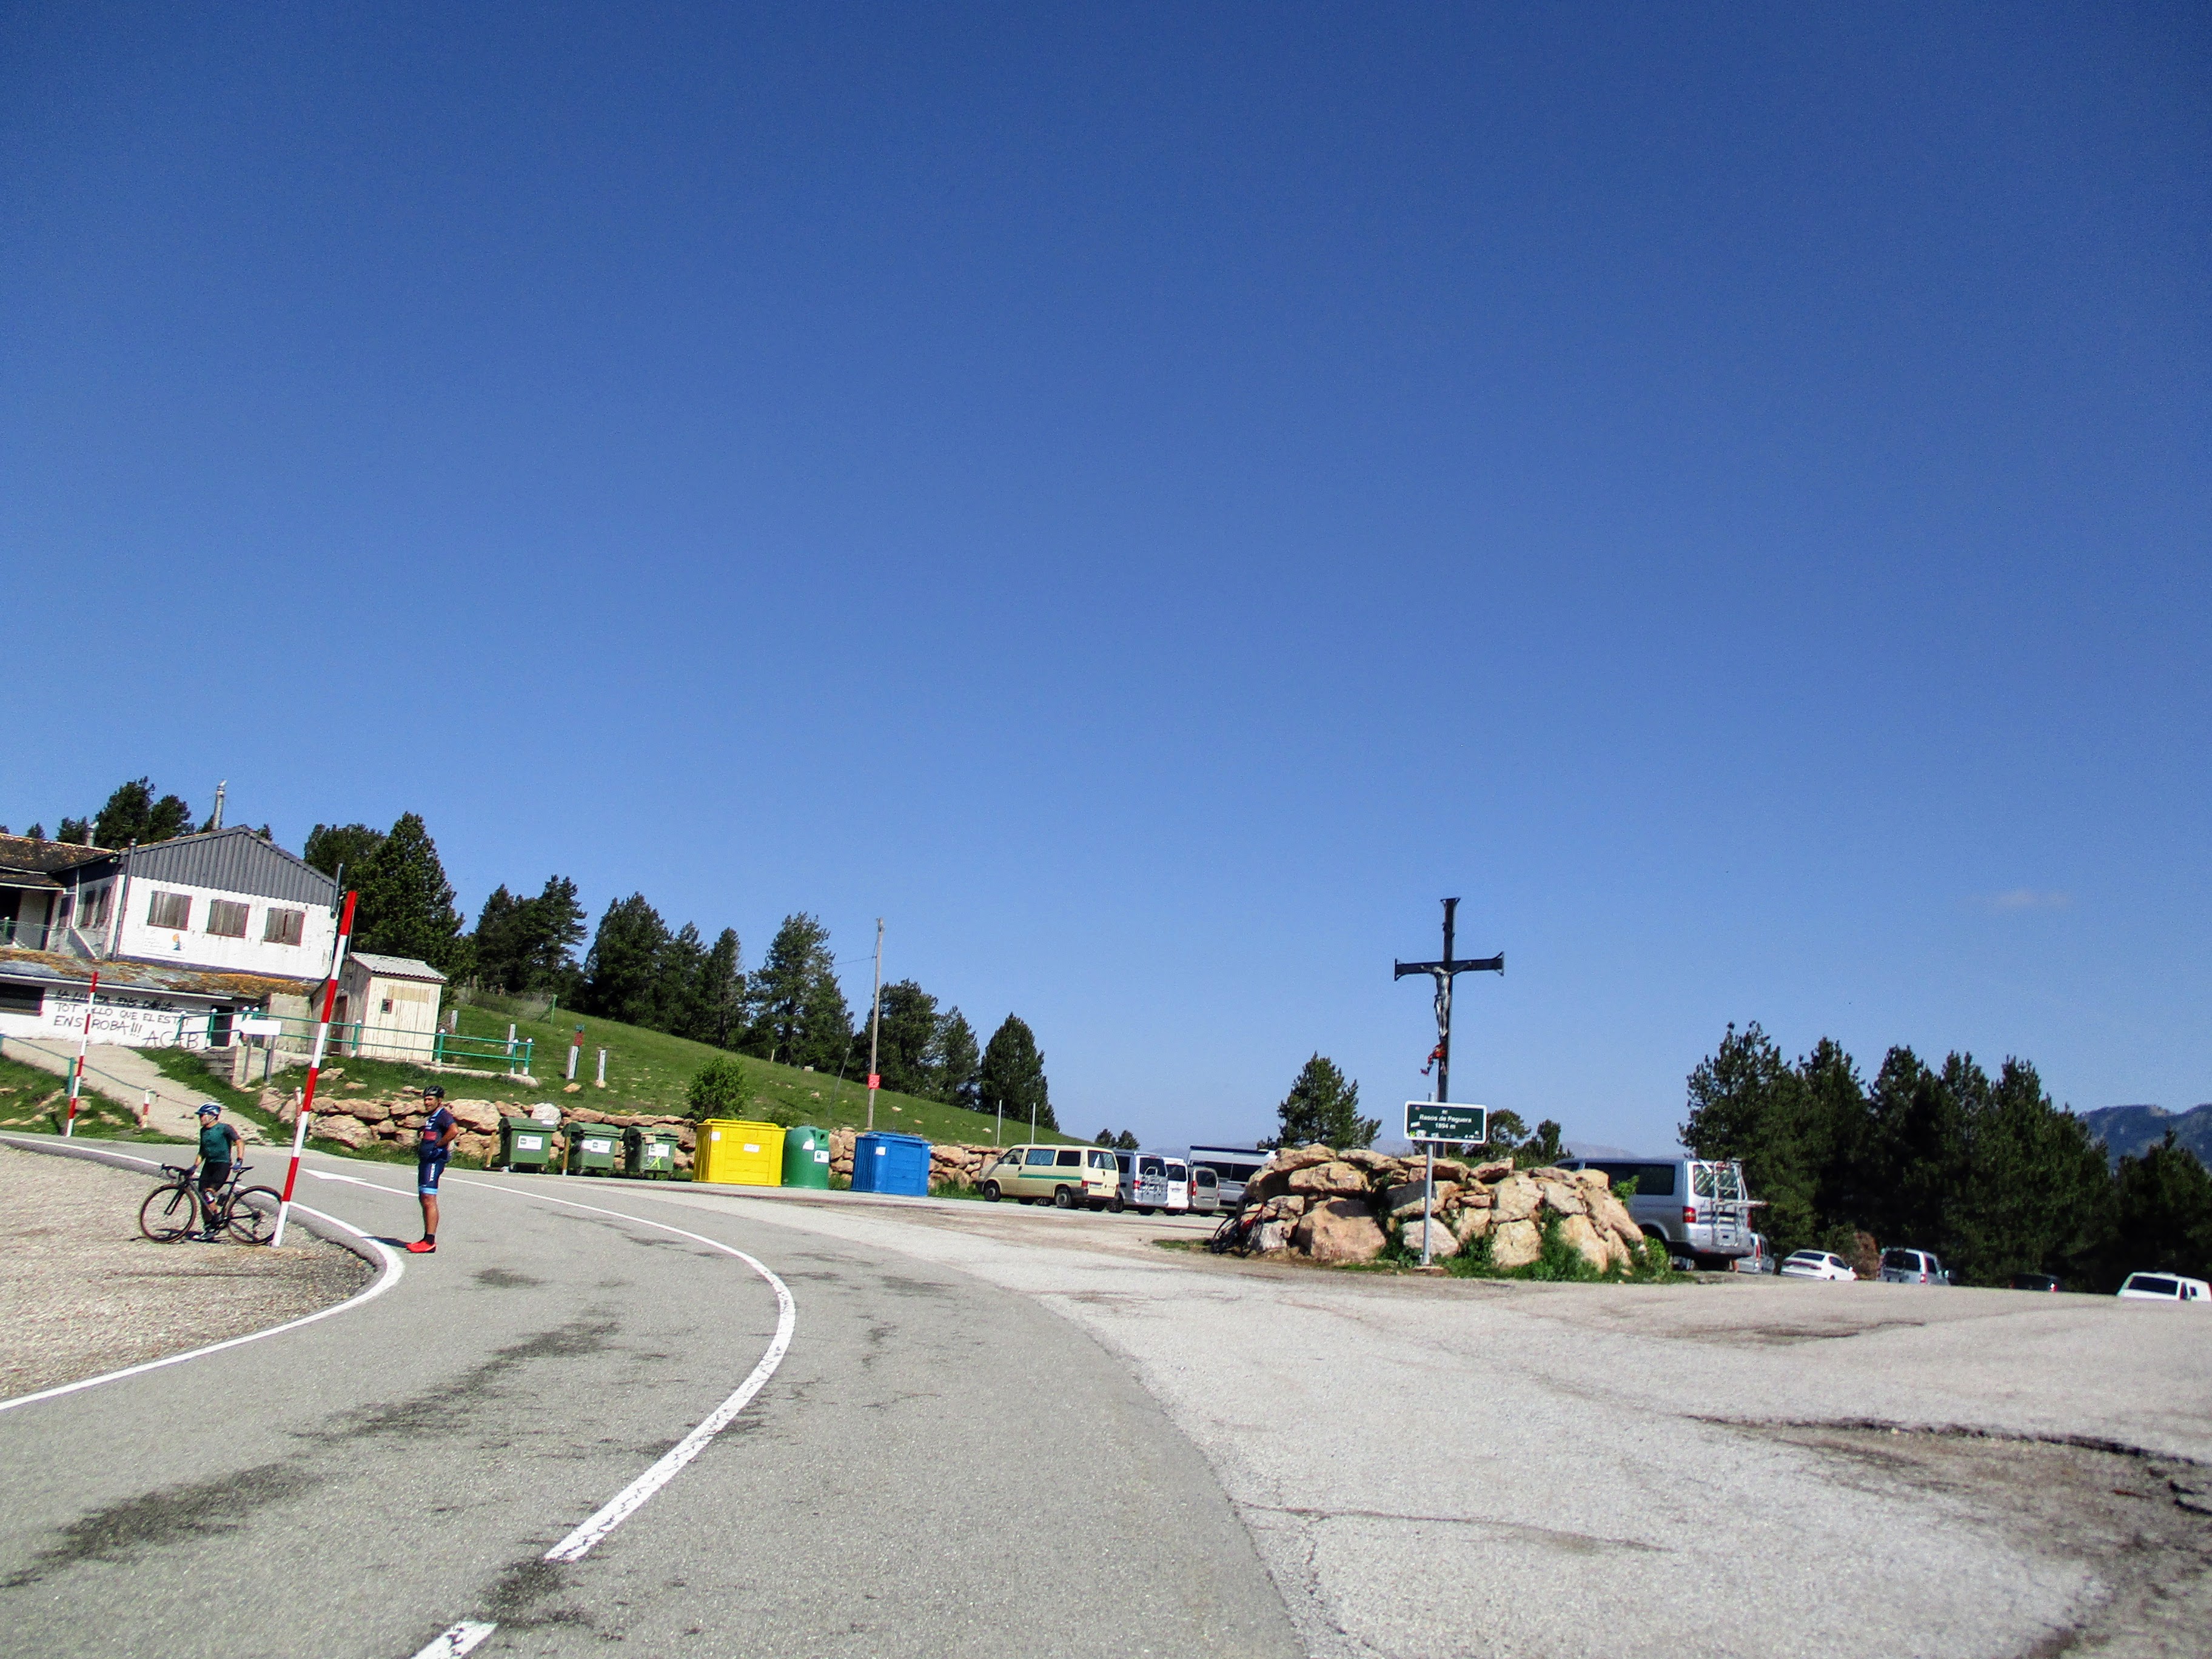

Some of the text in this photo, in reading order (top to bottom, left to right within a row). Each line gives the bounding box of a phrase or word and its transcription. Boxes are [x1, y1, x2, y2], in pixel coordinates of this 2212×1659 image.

[55, 1002, 81, 1012] TOT
[120, 1010, 138, 1020] QUE
[53, 1015, 84, 1027] ENS
[142, 1031, 199, 1049] ACAB
